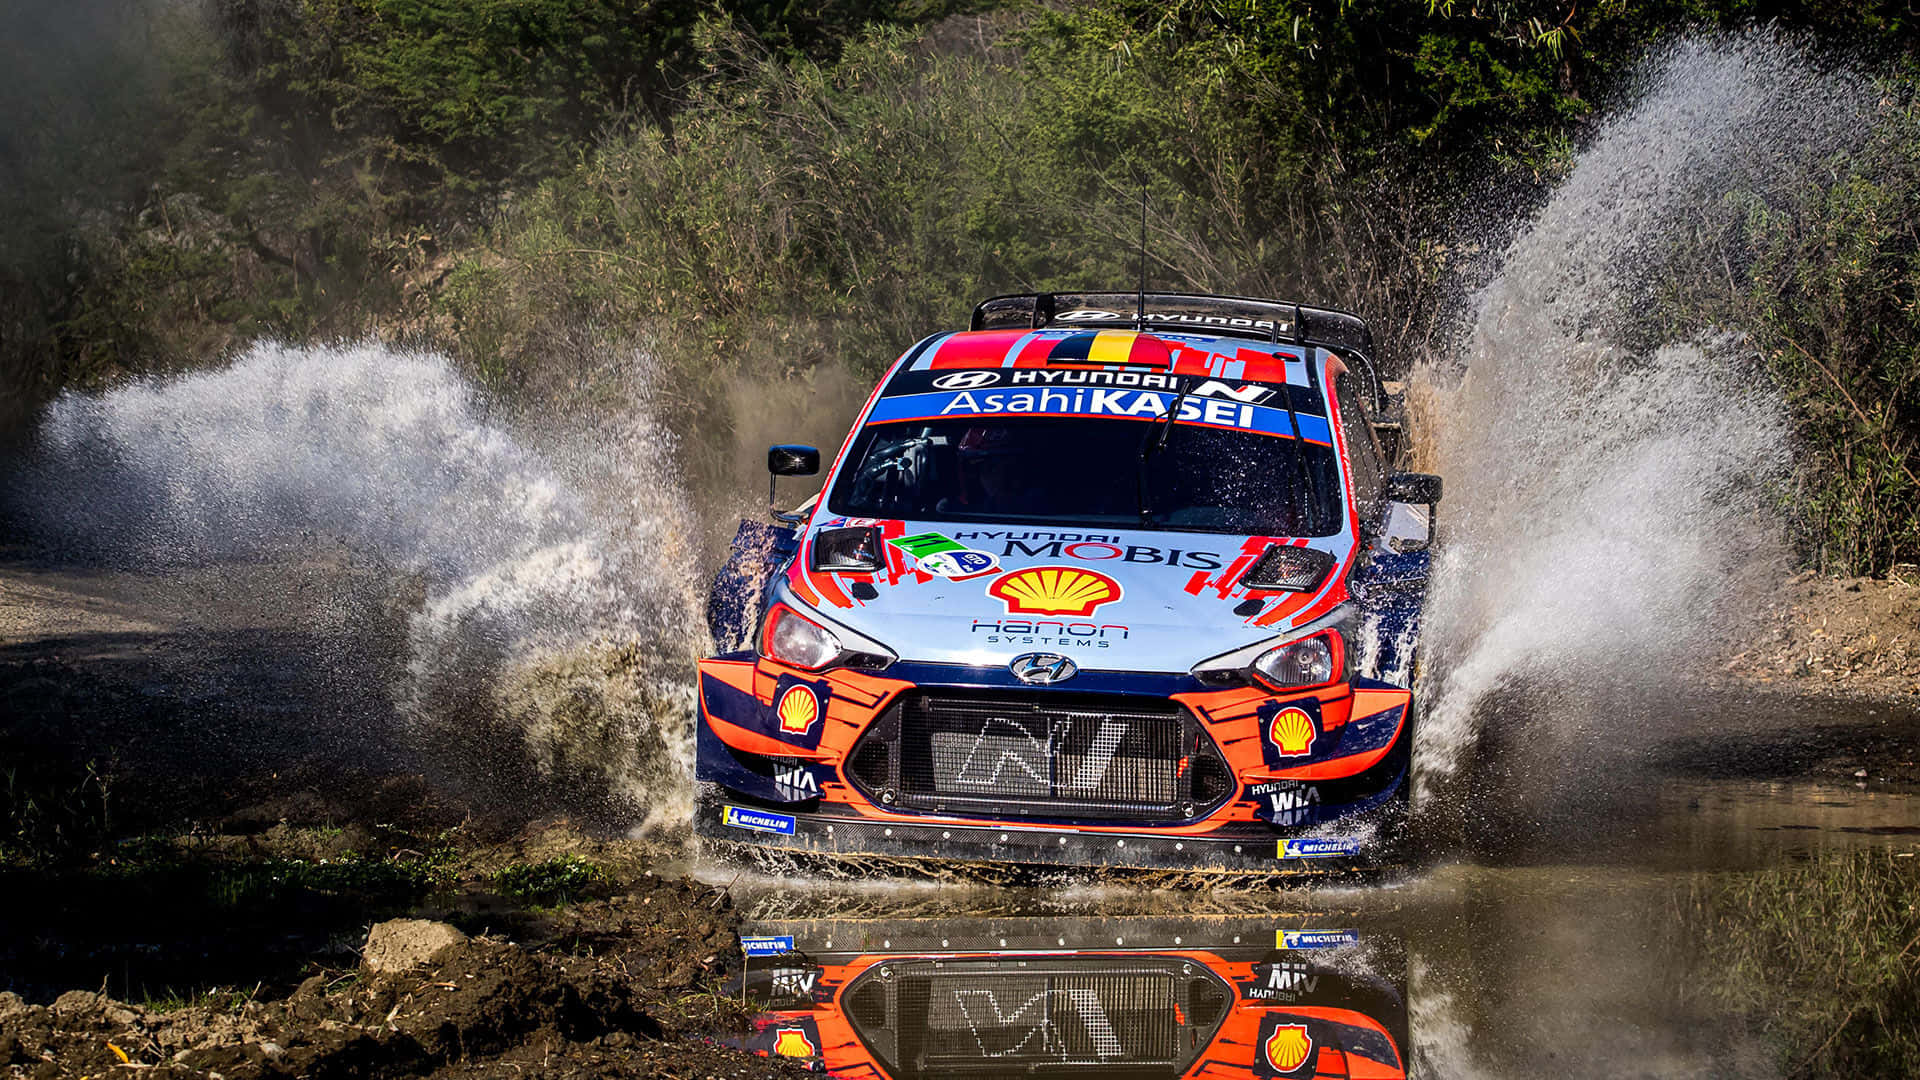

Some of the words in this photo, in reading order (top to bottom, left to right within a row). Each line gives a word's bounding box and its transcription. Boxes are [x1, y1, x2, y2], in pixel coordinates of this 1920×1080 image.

[1131, 313, 1289, 332] HYUNDAI
[1011, 370, 1178, 389] HYUNDAI
[954, 531, 1120, 544] HYUNDAI
[1000, 540, 1222, 570] MOBIS
[987, 635, 1110, 648] SYSTEMS
[1251, 779, 1299, 796] HYUNDAI
[739, 814, 789, 830] MICHELIN
[1302, 841, 1354, 853] MICHELIN
